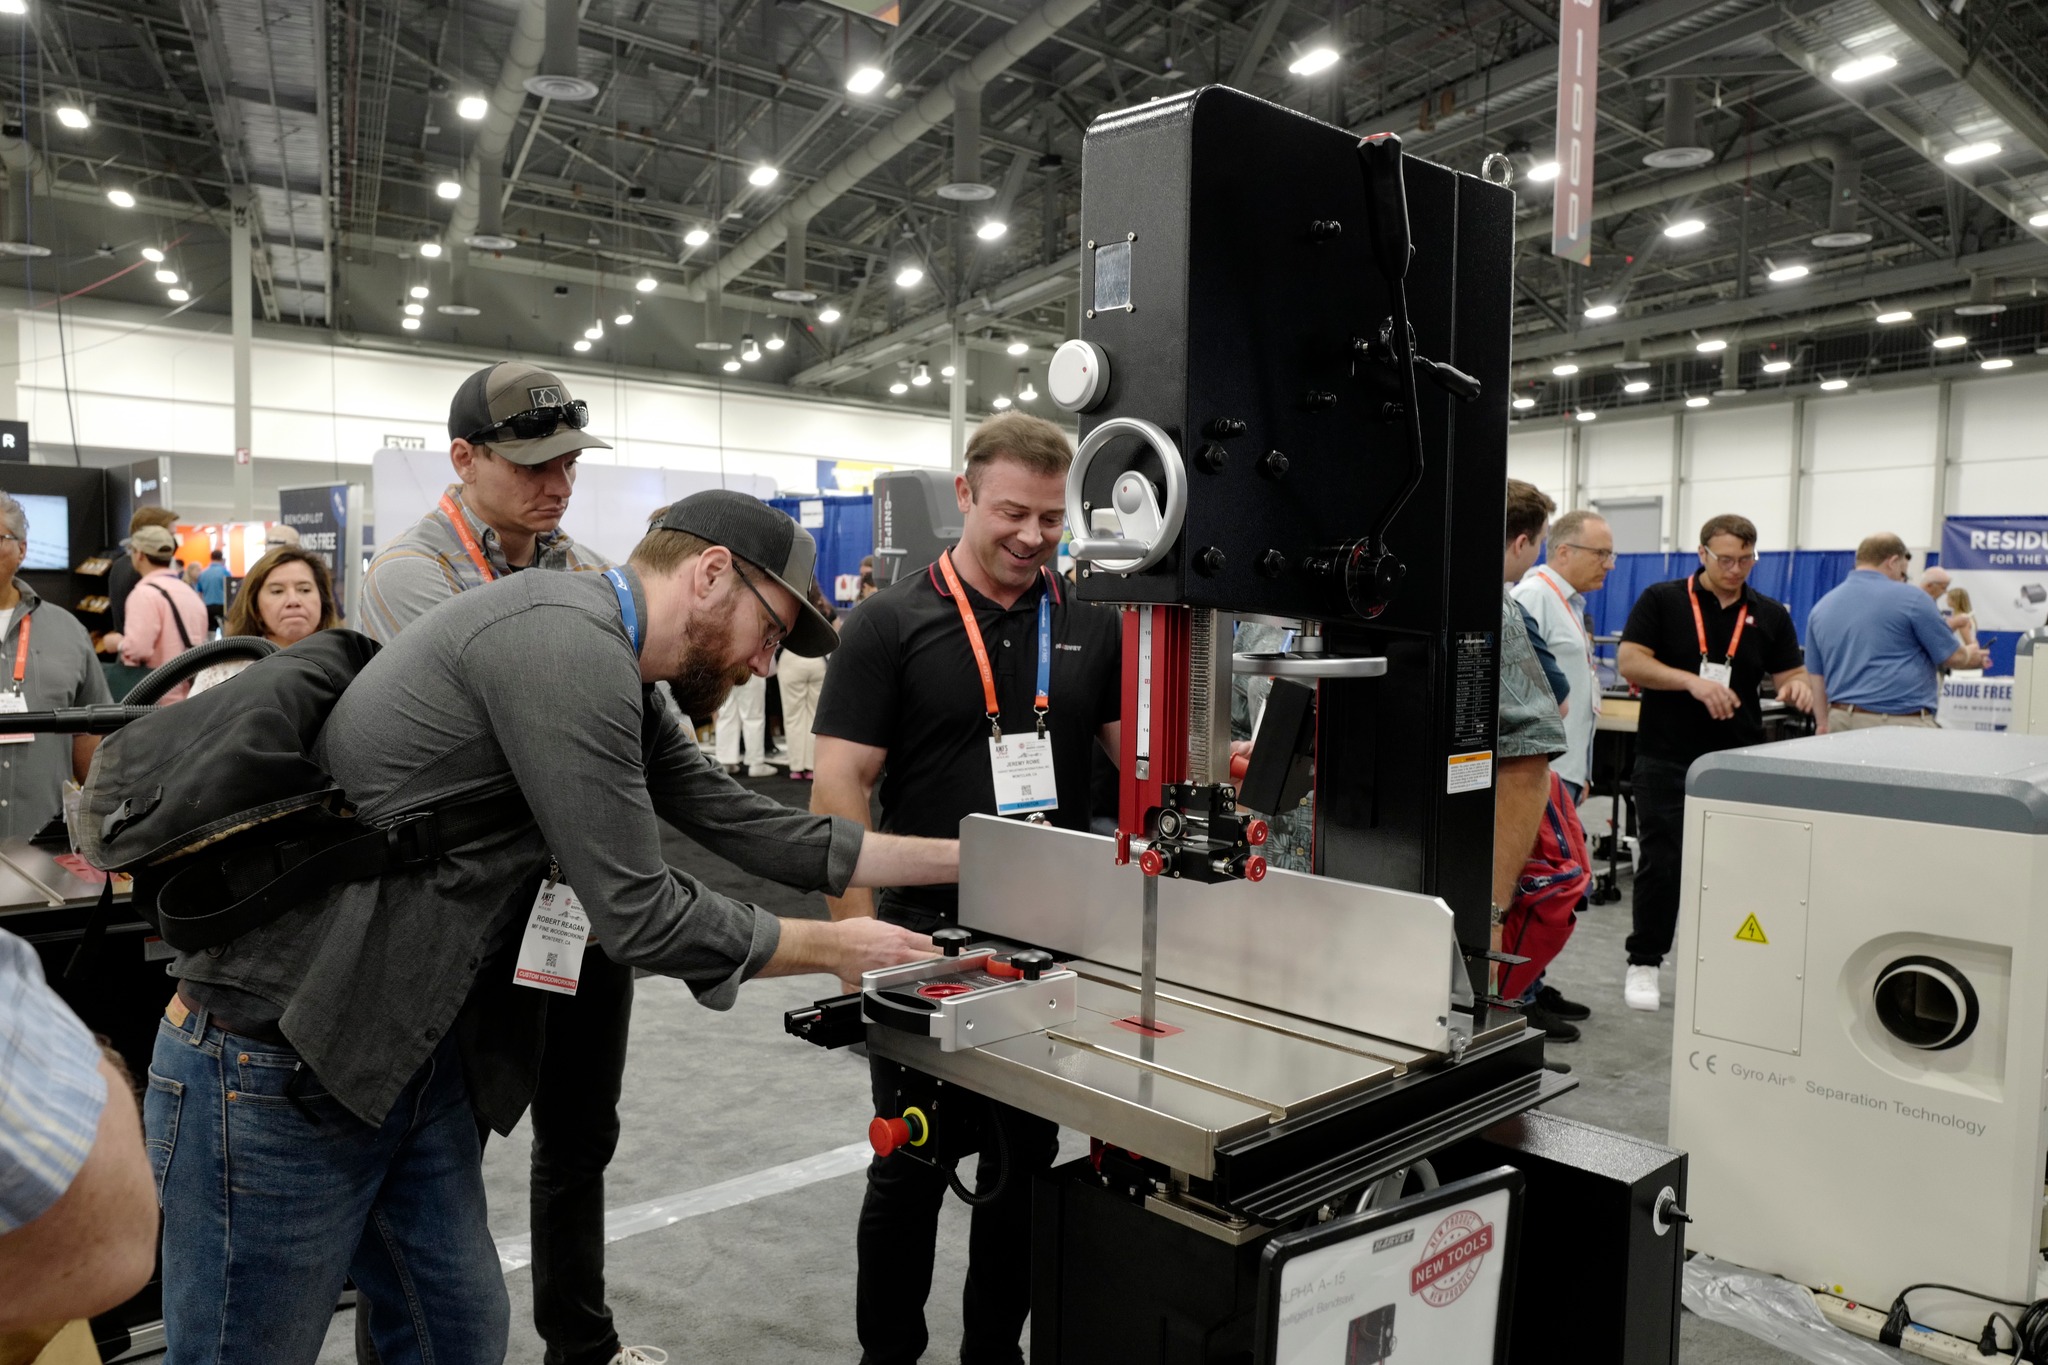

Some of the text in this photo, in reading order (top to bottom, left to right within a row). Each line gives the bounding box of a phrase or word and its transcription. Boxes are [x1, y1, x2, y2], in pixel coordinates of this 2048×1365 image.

[884, 500, 892, 549] SNIPE
[1989, 554, 2014, 564] FOR
[2016, 554, 2042, 565] THE
[1983, 685, 2012, 700] FREE
[541, 892, 556, 903] AWFS
[536, 914, 561, 927] ROBERT
[561, 920, 585, 932] REAGAN
[539, 925, 550, 933] FINE
[549, 928, 585, 941] WOODWORKING
[518, 970, 540, 980] CUSTOM
[539, 974, 576, 988] WOODWORKING
[1730, 1063, 1764, 1082] Gyro
[1805, 1080, 1888, 1111] Separation
[1893, 1100, 1986, 1137] Technology
[1430, 1212, 1477, 1249] NEW PRODUCT
[1374, 1230, 1414, 1251] HARVEY
[1416, 1233, 1488, 1285] NEW TOOLS
[1318, 1271, 1346, 1291] A-15
